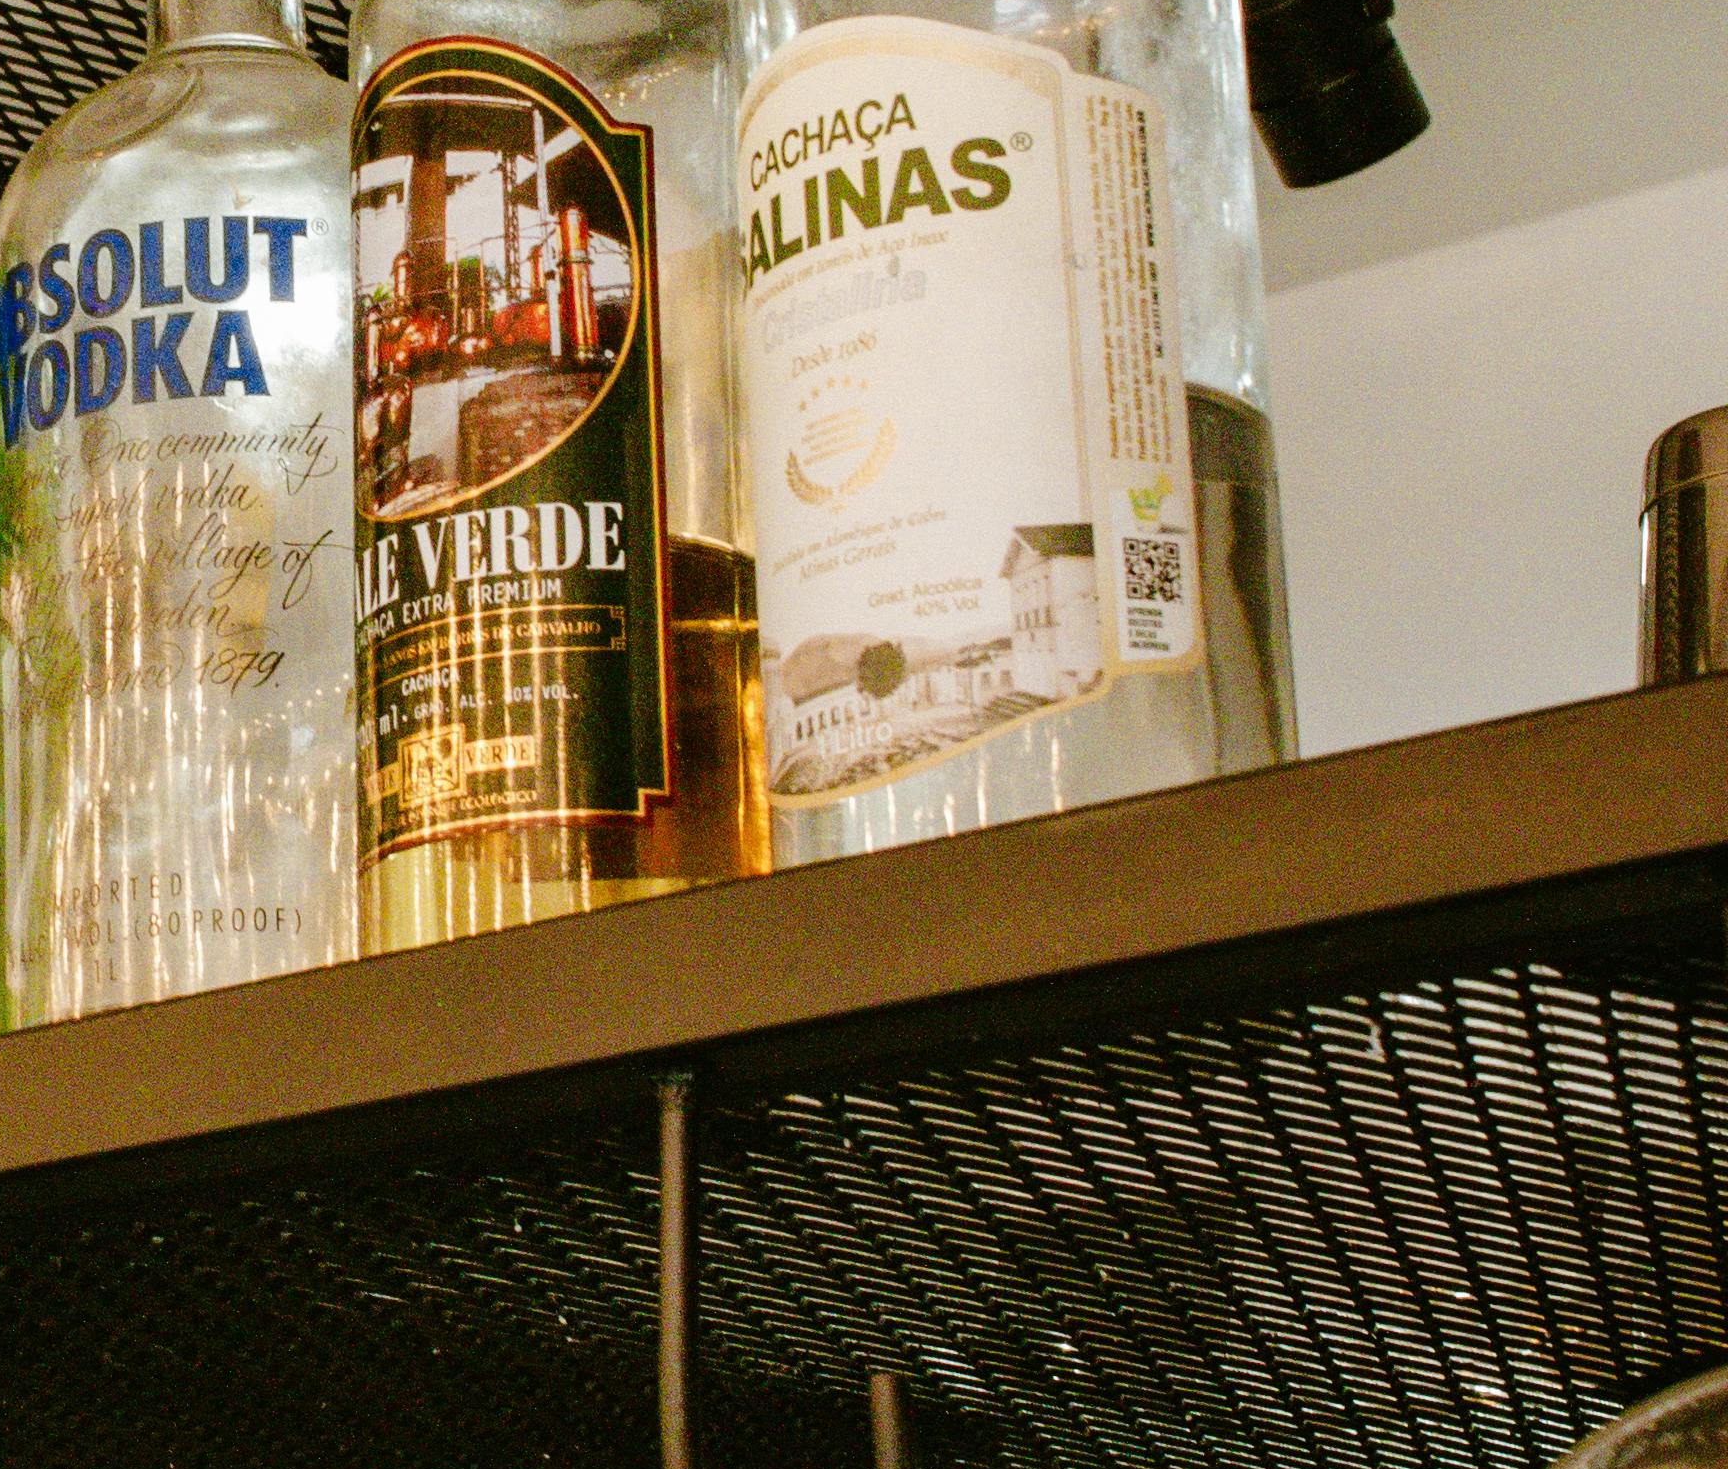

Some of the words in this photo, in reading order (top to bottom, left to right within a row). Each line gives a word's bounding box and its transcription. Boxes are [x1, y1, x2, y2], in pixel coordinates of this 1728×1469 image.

[749, 92, 918, 193] CACHAÇA
[740, 136, 1012, 302] ALINAS
[281, 530, 354, 611] of
[411, 501, 626, 590] VERDE
[402, 591, 455, 625] EXTRA
[467, 577, 563, 607] PREMIUM
[52, 872, 183, 915] MPORTED
